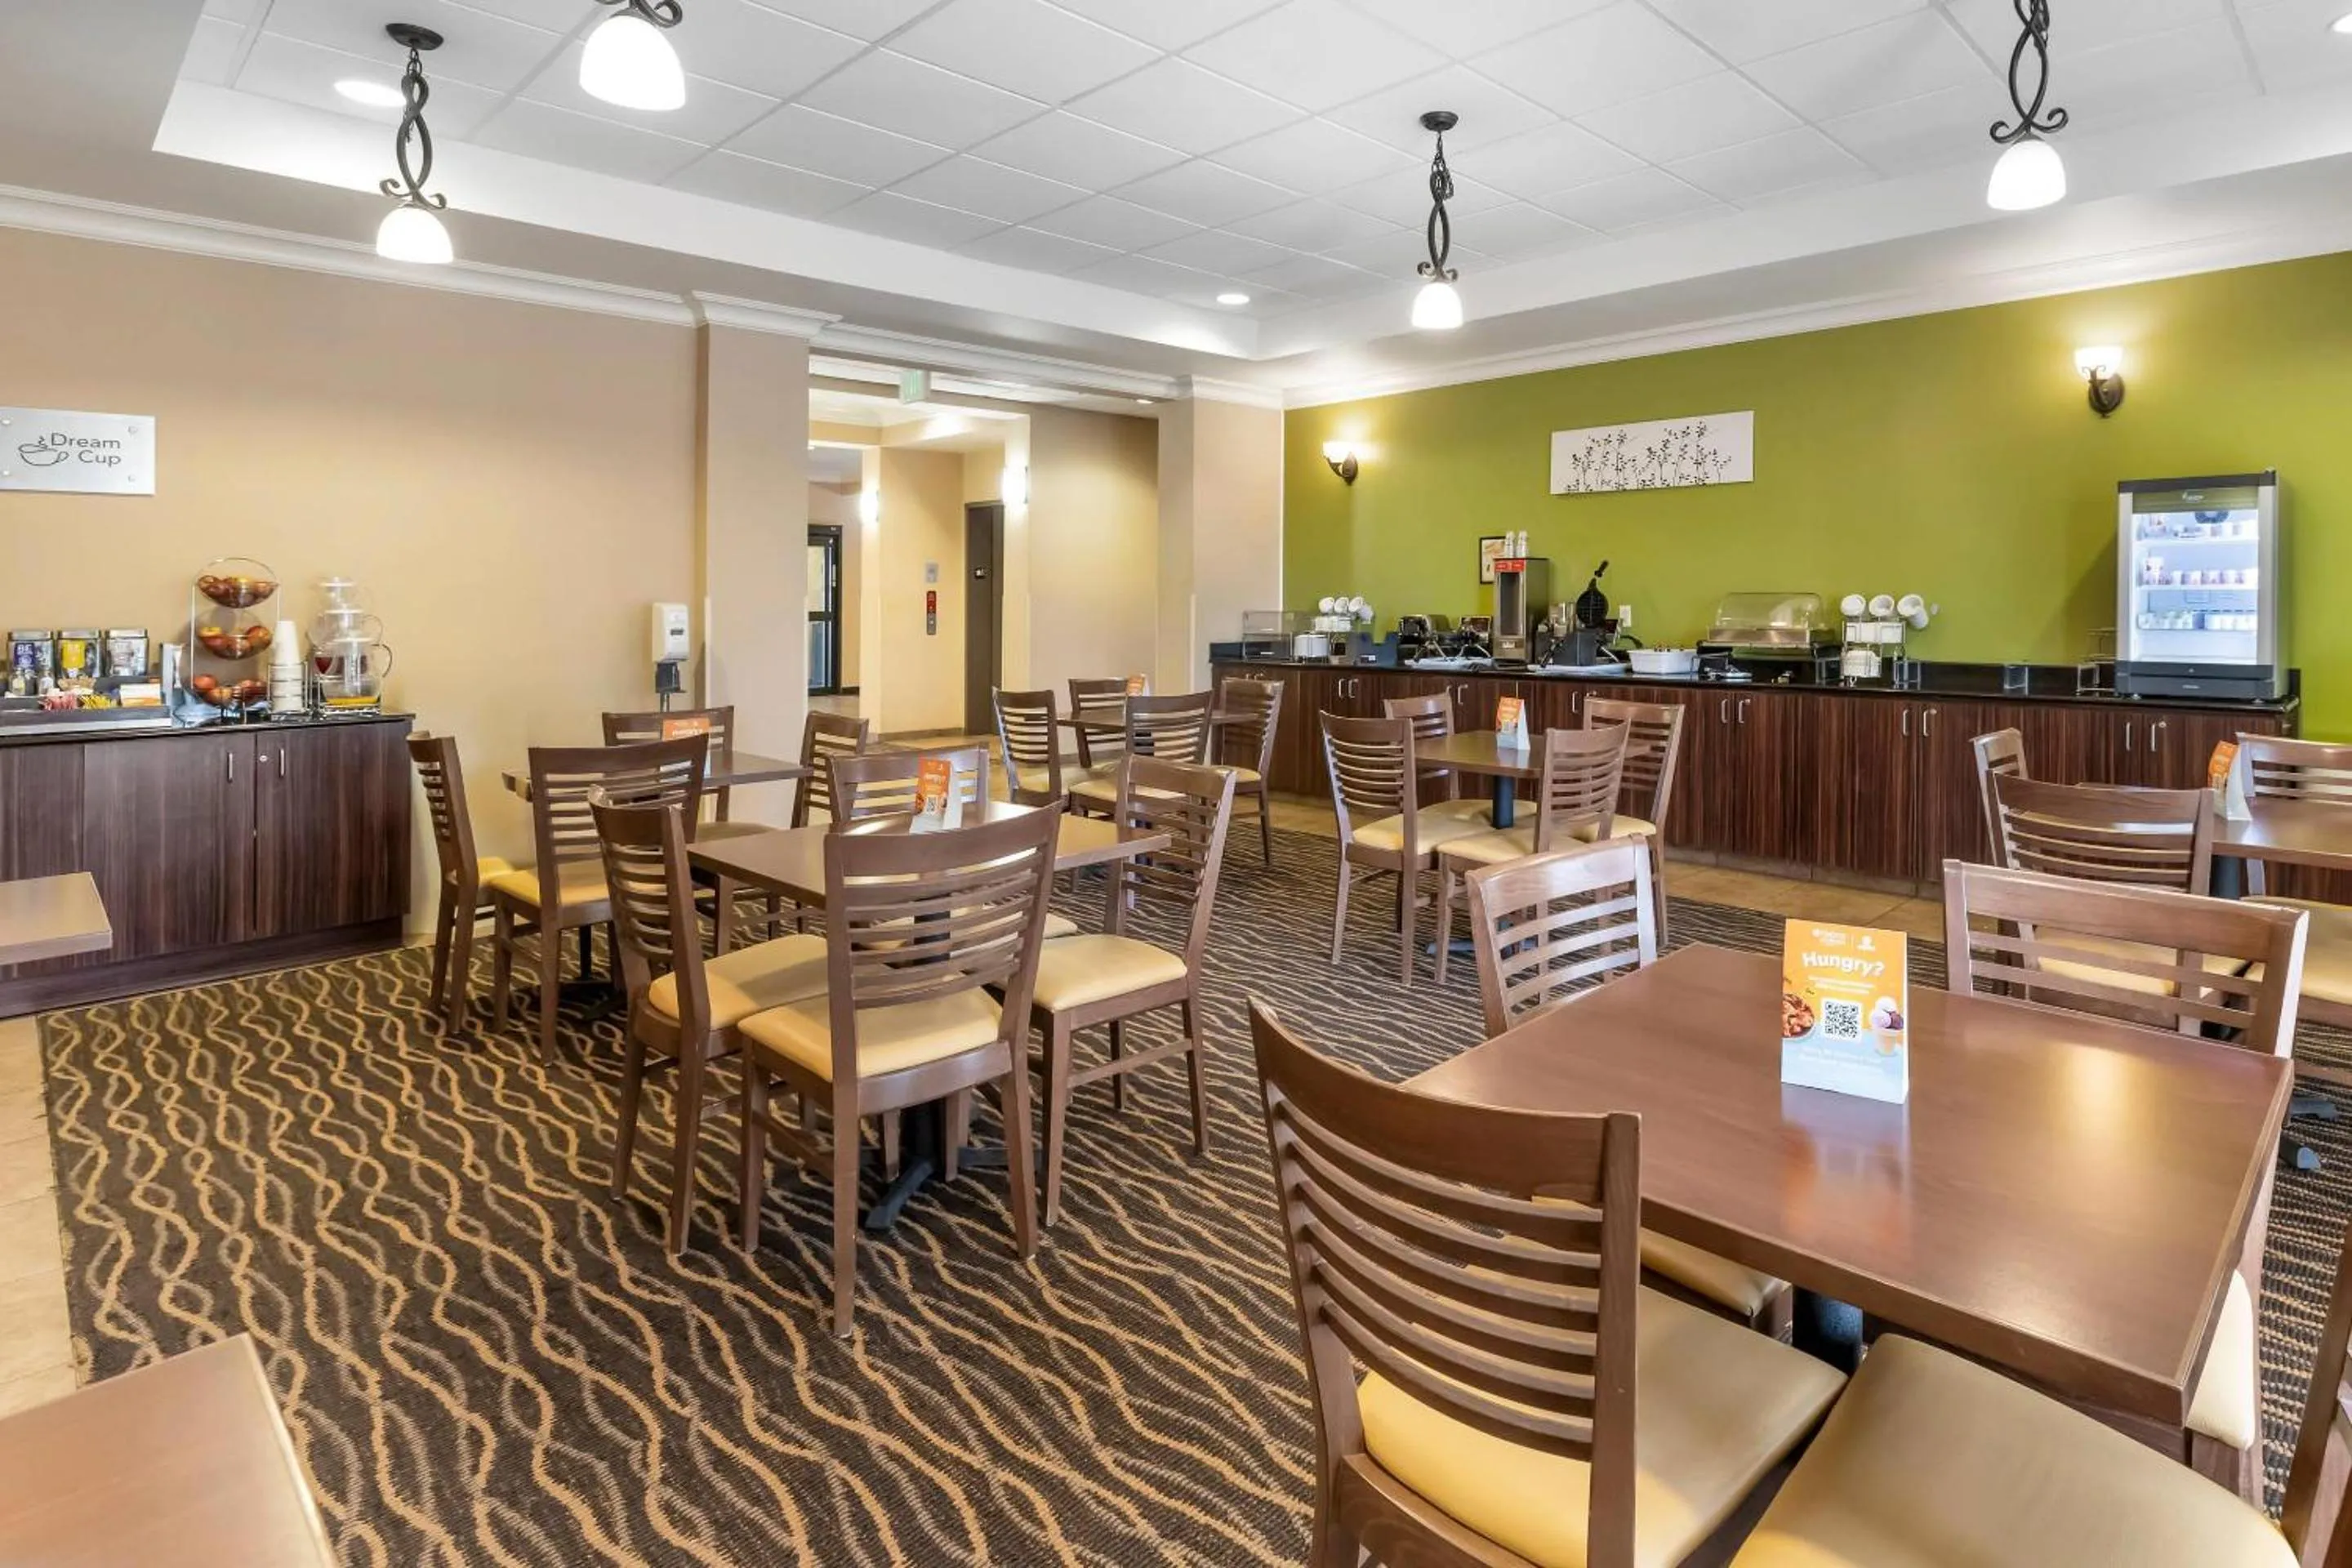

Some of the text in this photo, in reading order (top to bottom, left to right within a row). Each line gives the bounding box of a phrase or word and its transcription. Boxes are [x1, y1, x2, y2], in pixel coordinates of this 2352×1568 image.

[51, 432, 121, 449] Dream
[78, 449, 122, 468] Cup
[1802, 951, 1885, 978] Hungry?
